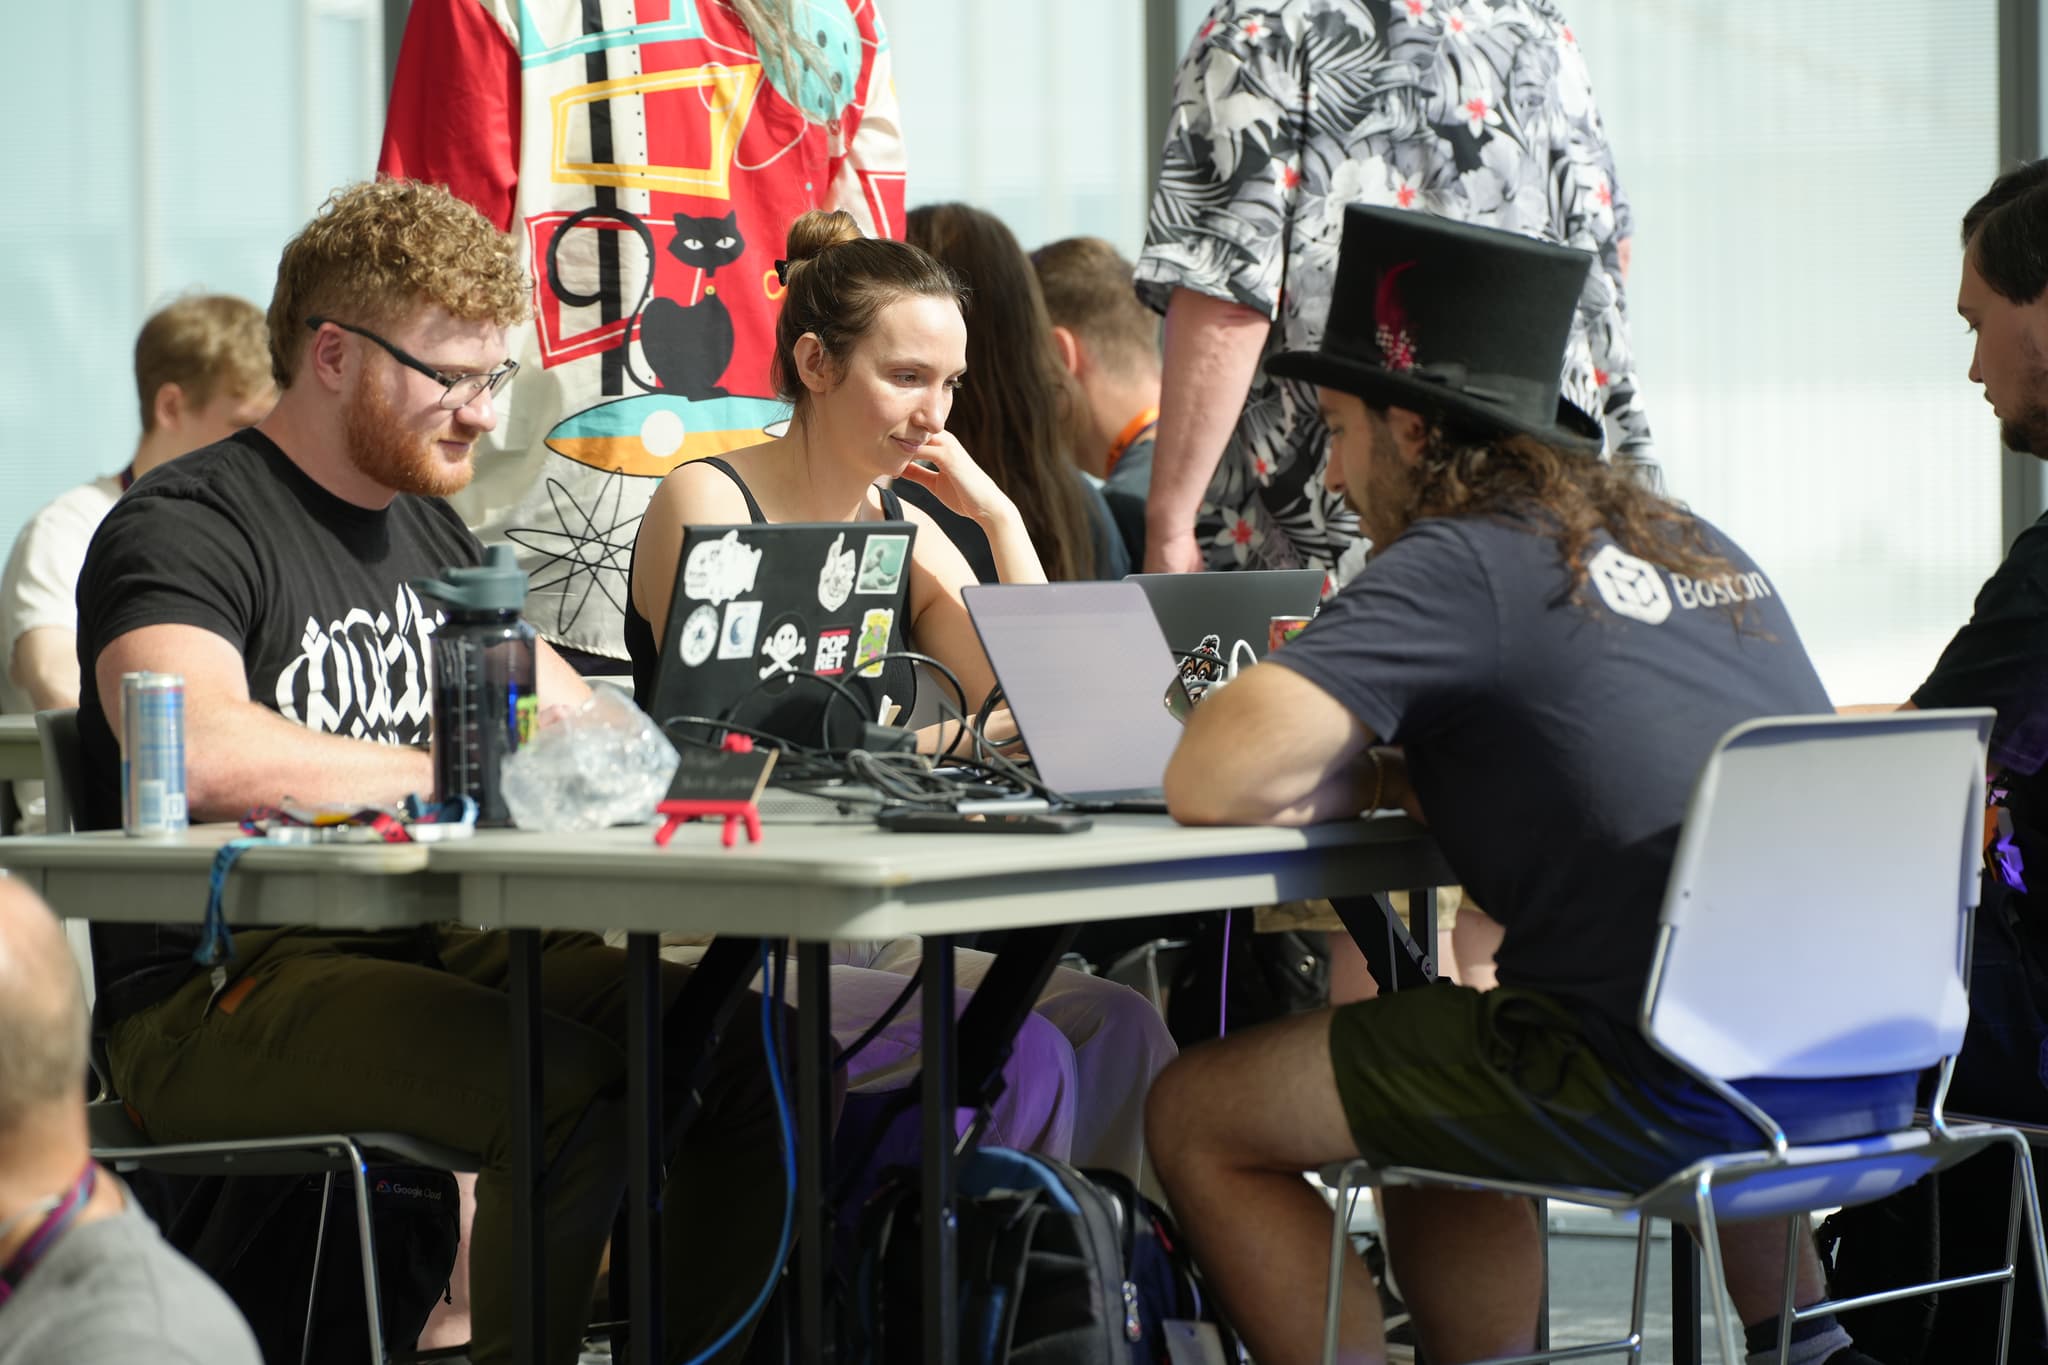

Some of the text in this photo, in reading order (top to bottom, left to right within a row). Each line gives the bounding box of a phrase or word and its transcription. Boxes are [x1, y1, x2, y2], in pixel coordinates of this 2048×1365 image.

[1670, 571, 1771, 609] Boston
[817, 635, 849, 653] POP
[814, 651, 847, 671] RET
[392, 1183, 442, 1200] Google Cloud
